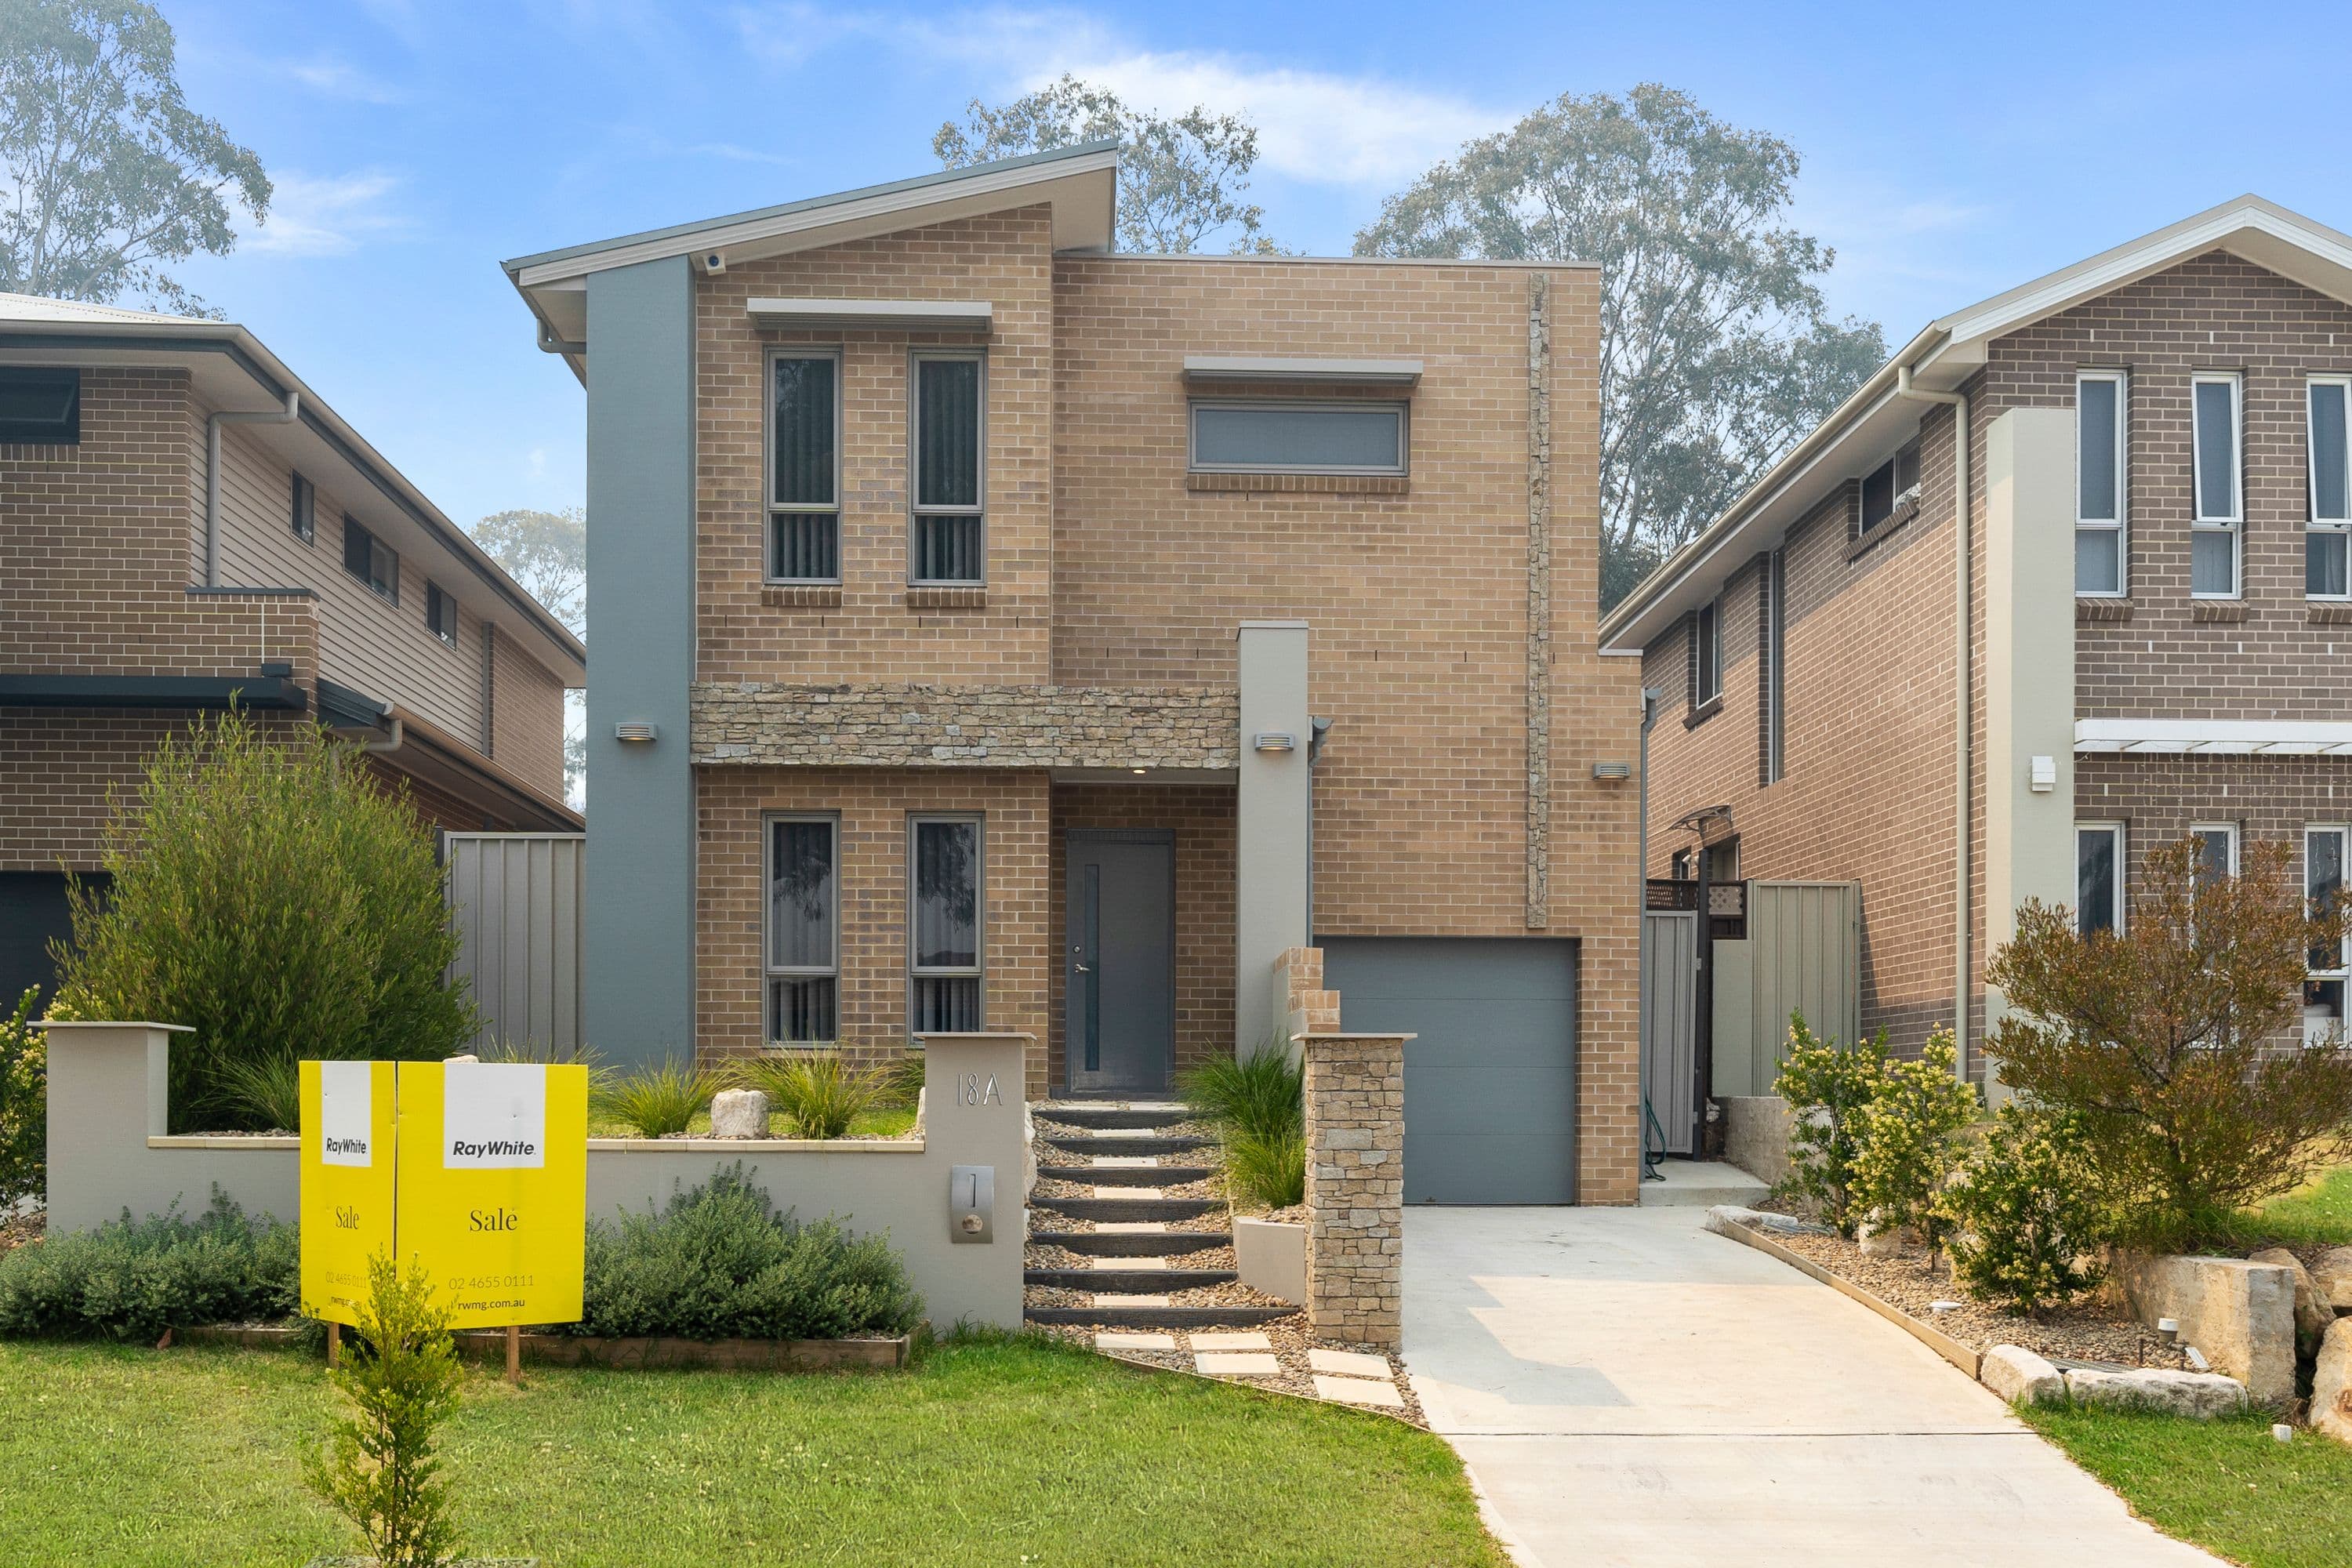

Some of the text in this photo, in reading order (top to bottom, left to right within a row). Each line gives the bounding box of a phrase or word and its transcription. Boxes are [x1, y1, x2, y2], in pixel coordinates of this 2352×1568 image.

[958, 1073, 1004, 1105] 18A
[336, 1206, 359, 1229] Sale
[470, 1207, 517, 1232] Sale
[326, 1272, 367, 1288] 02 4655 0111
[448, 1275, 534, 1290] 02 4655 0111
[458, 1299, 525, 1311] rwmg.com.au
